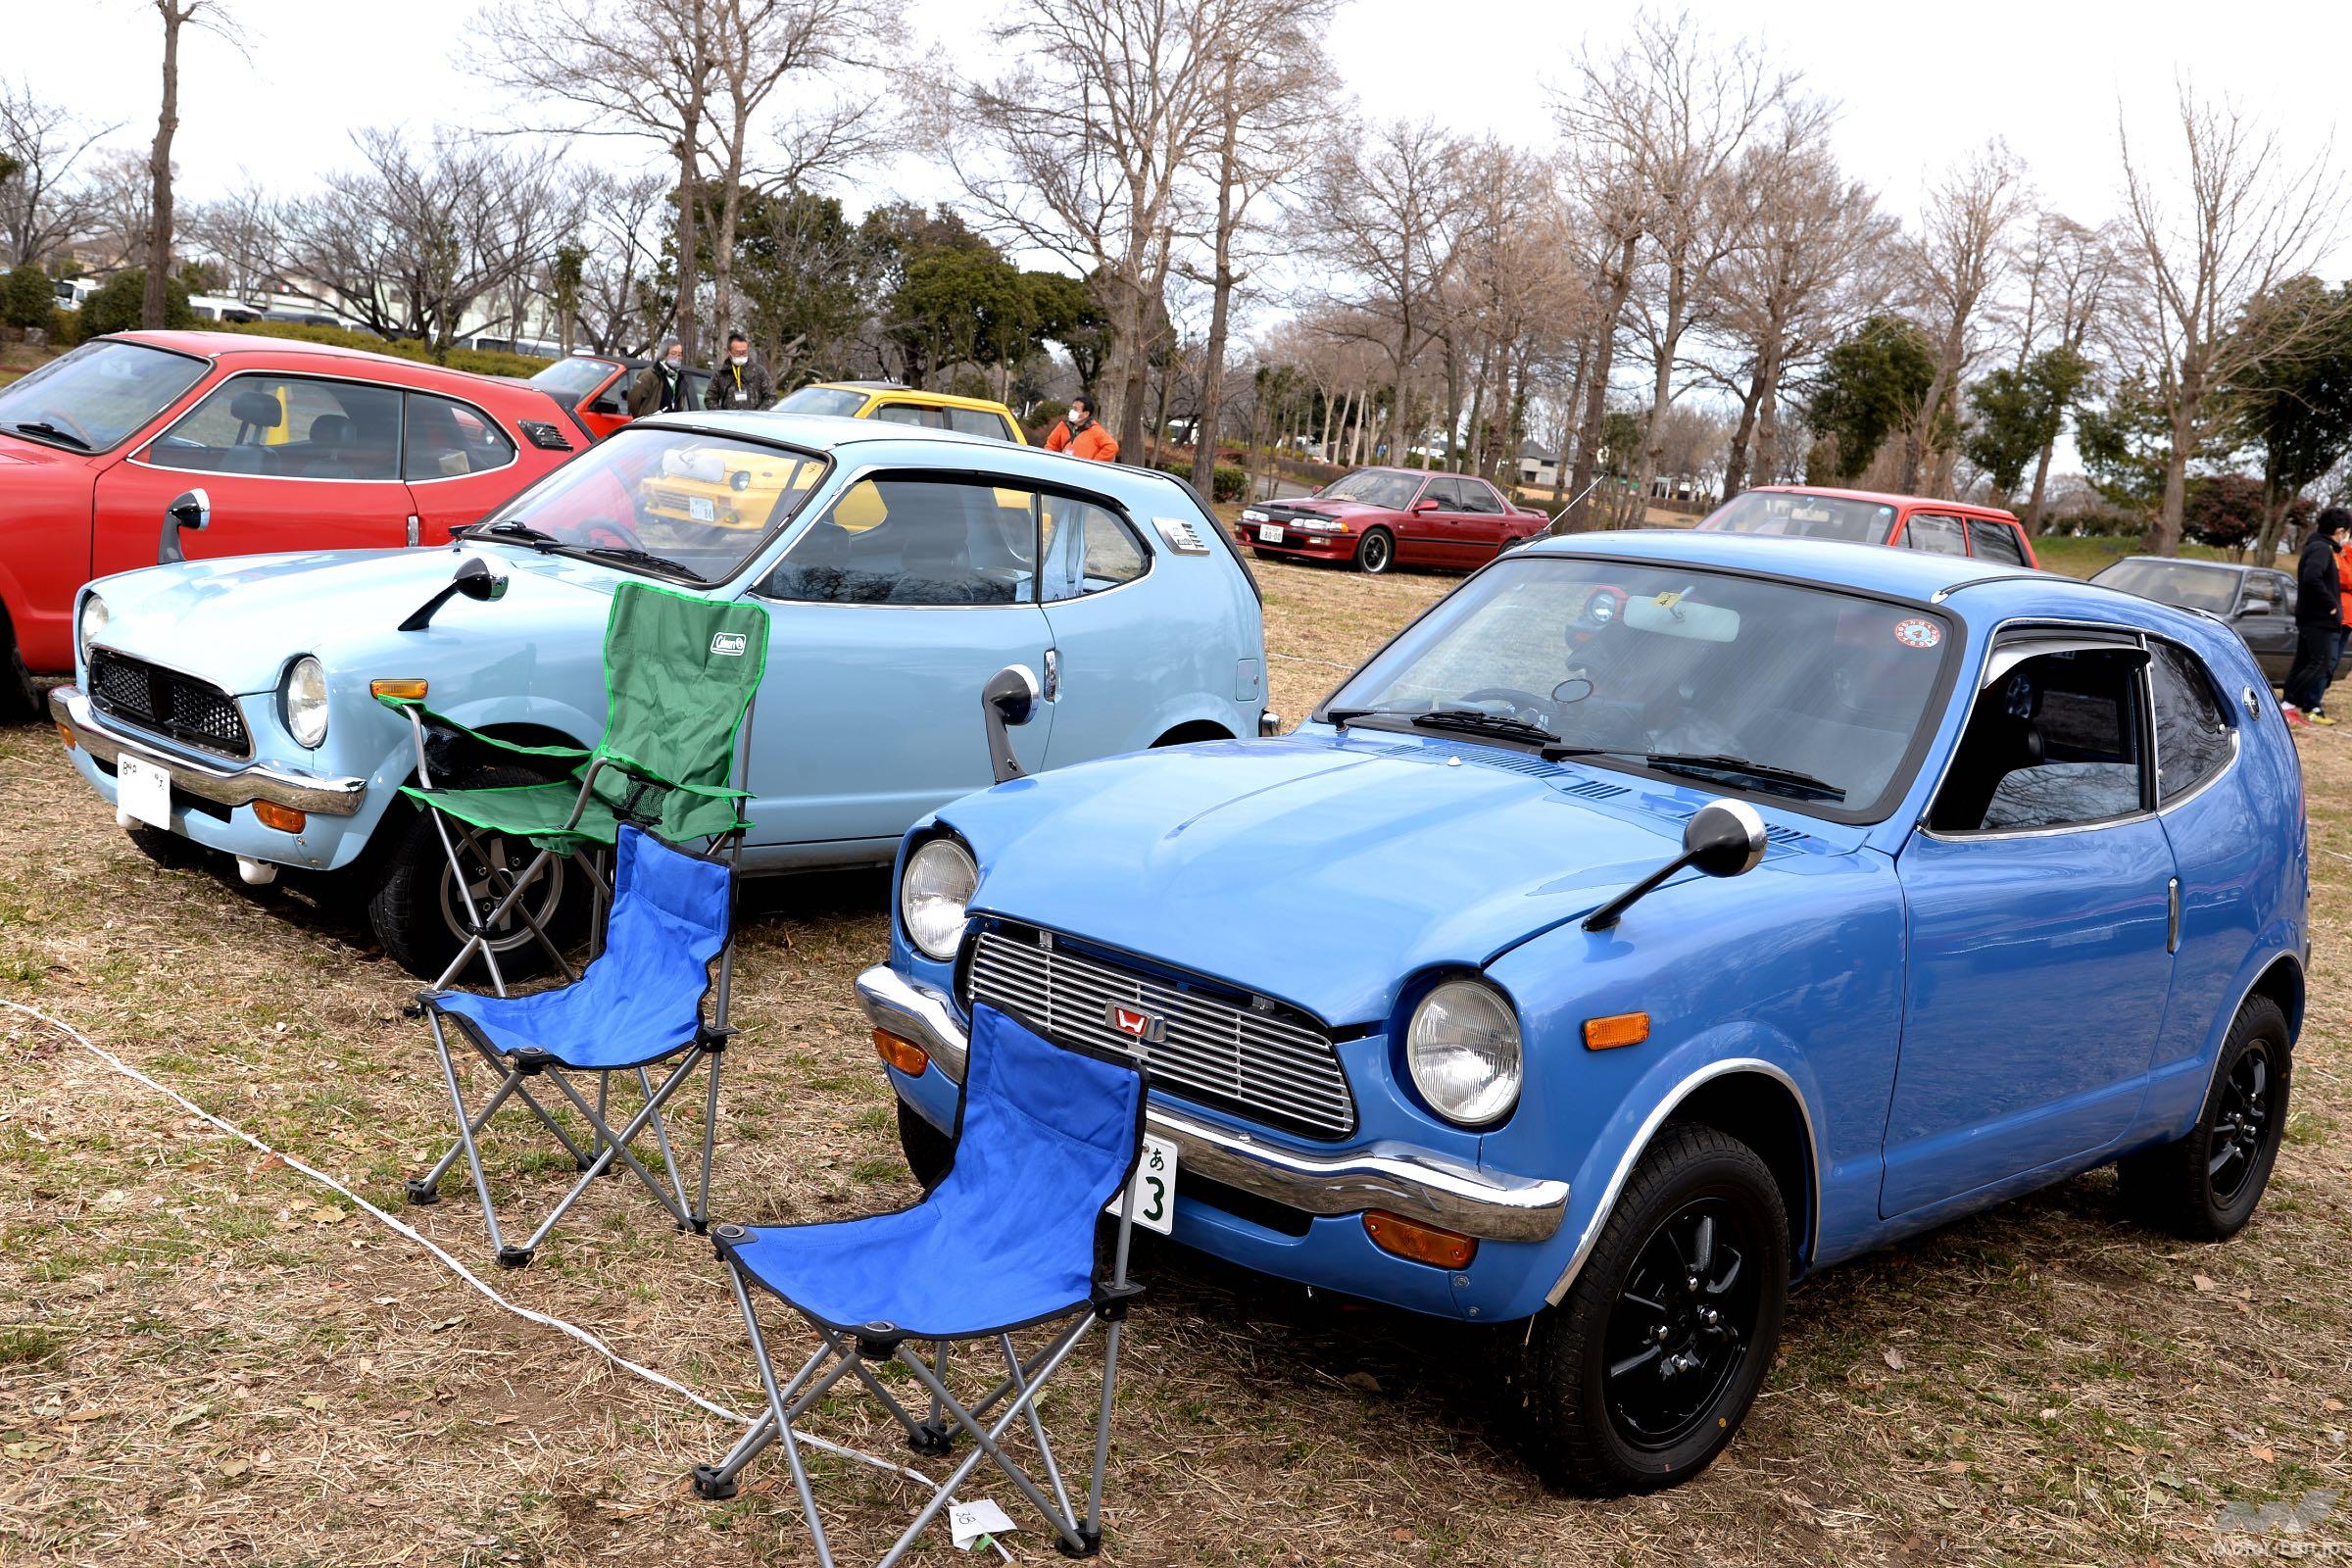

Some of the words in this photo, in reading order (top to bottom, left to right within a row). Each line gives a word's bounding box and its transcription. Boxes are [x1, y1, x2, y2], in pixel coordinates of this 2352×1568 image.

[535, 426, 546, 436] Z
[1150, 1147, 1164, 1171] あ
[1143, 1176, 1165, 1221] 3
